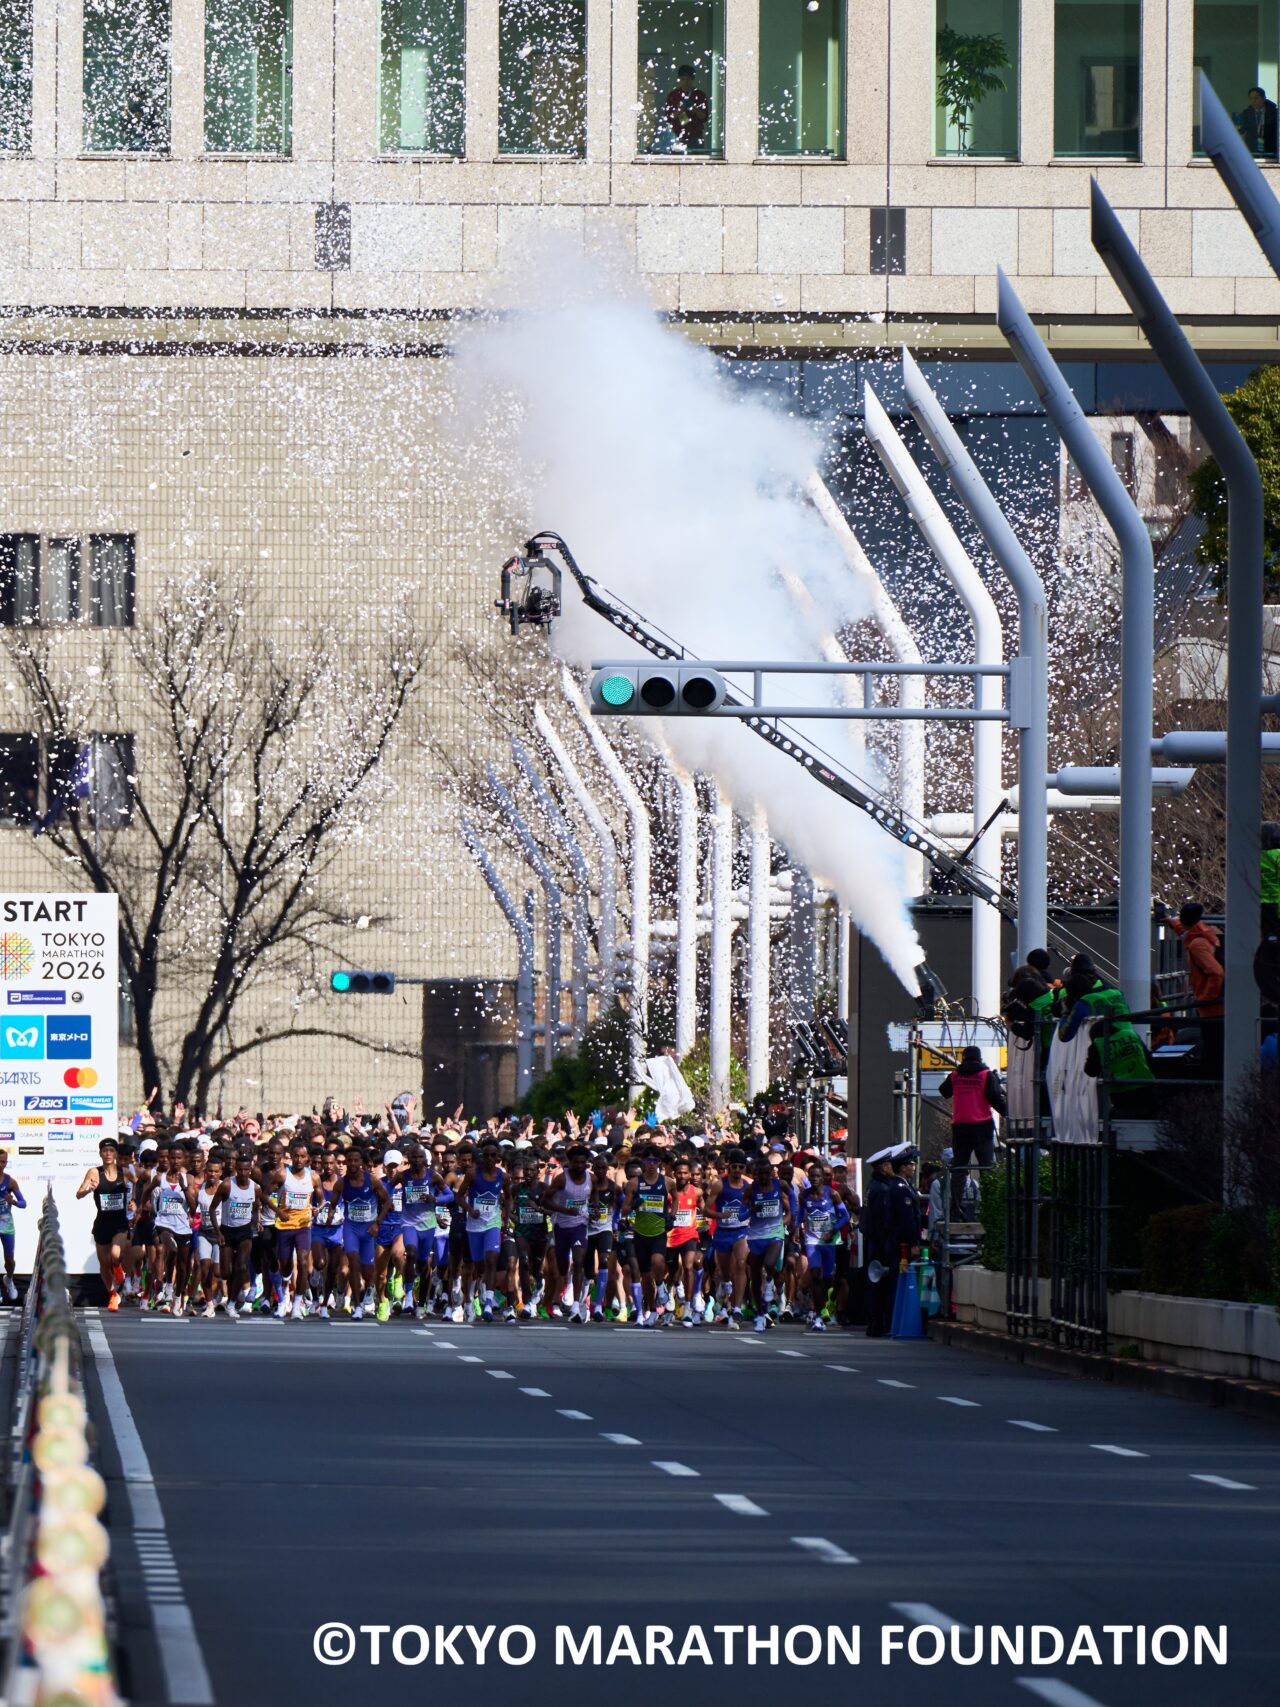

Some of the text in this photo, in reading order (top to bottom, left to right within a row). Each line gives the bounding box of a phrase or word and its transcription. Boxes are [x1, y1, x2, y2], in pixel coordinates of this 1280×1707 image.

[4, 901, 87, 921] START
[42, 933, 105, 946] TOKYO
[43, 950, 104, 958] MARATHON
[42, 961, 105, 979] 2026
[50, 1033, 88, 1041] 東京メトロ
